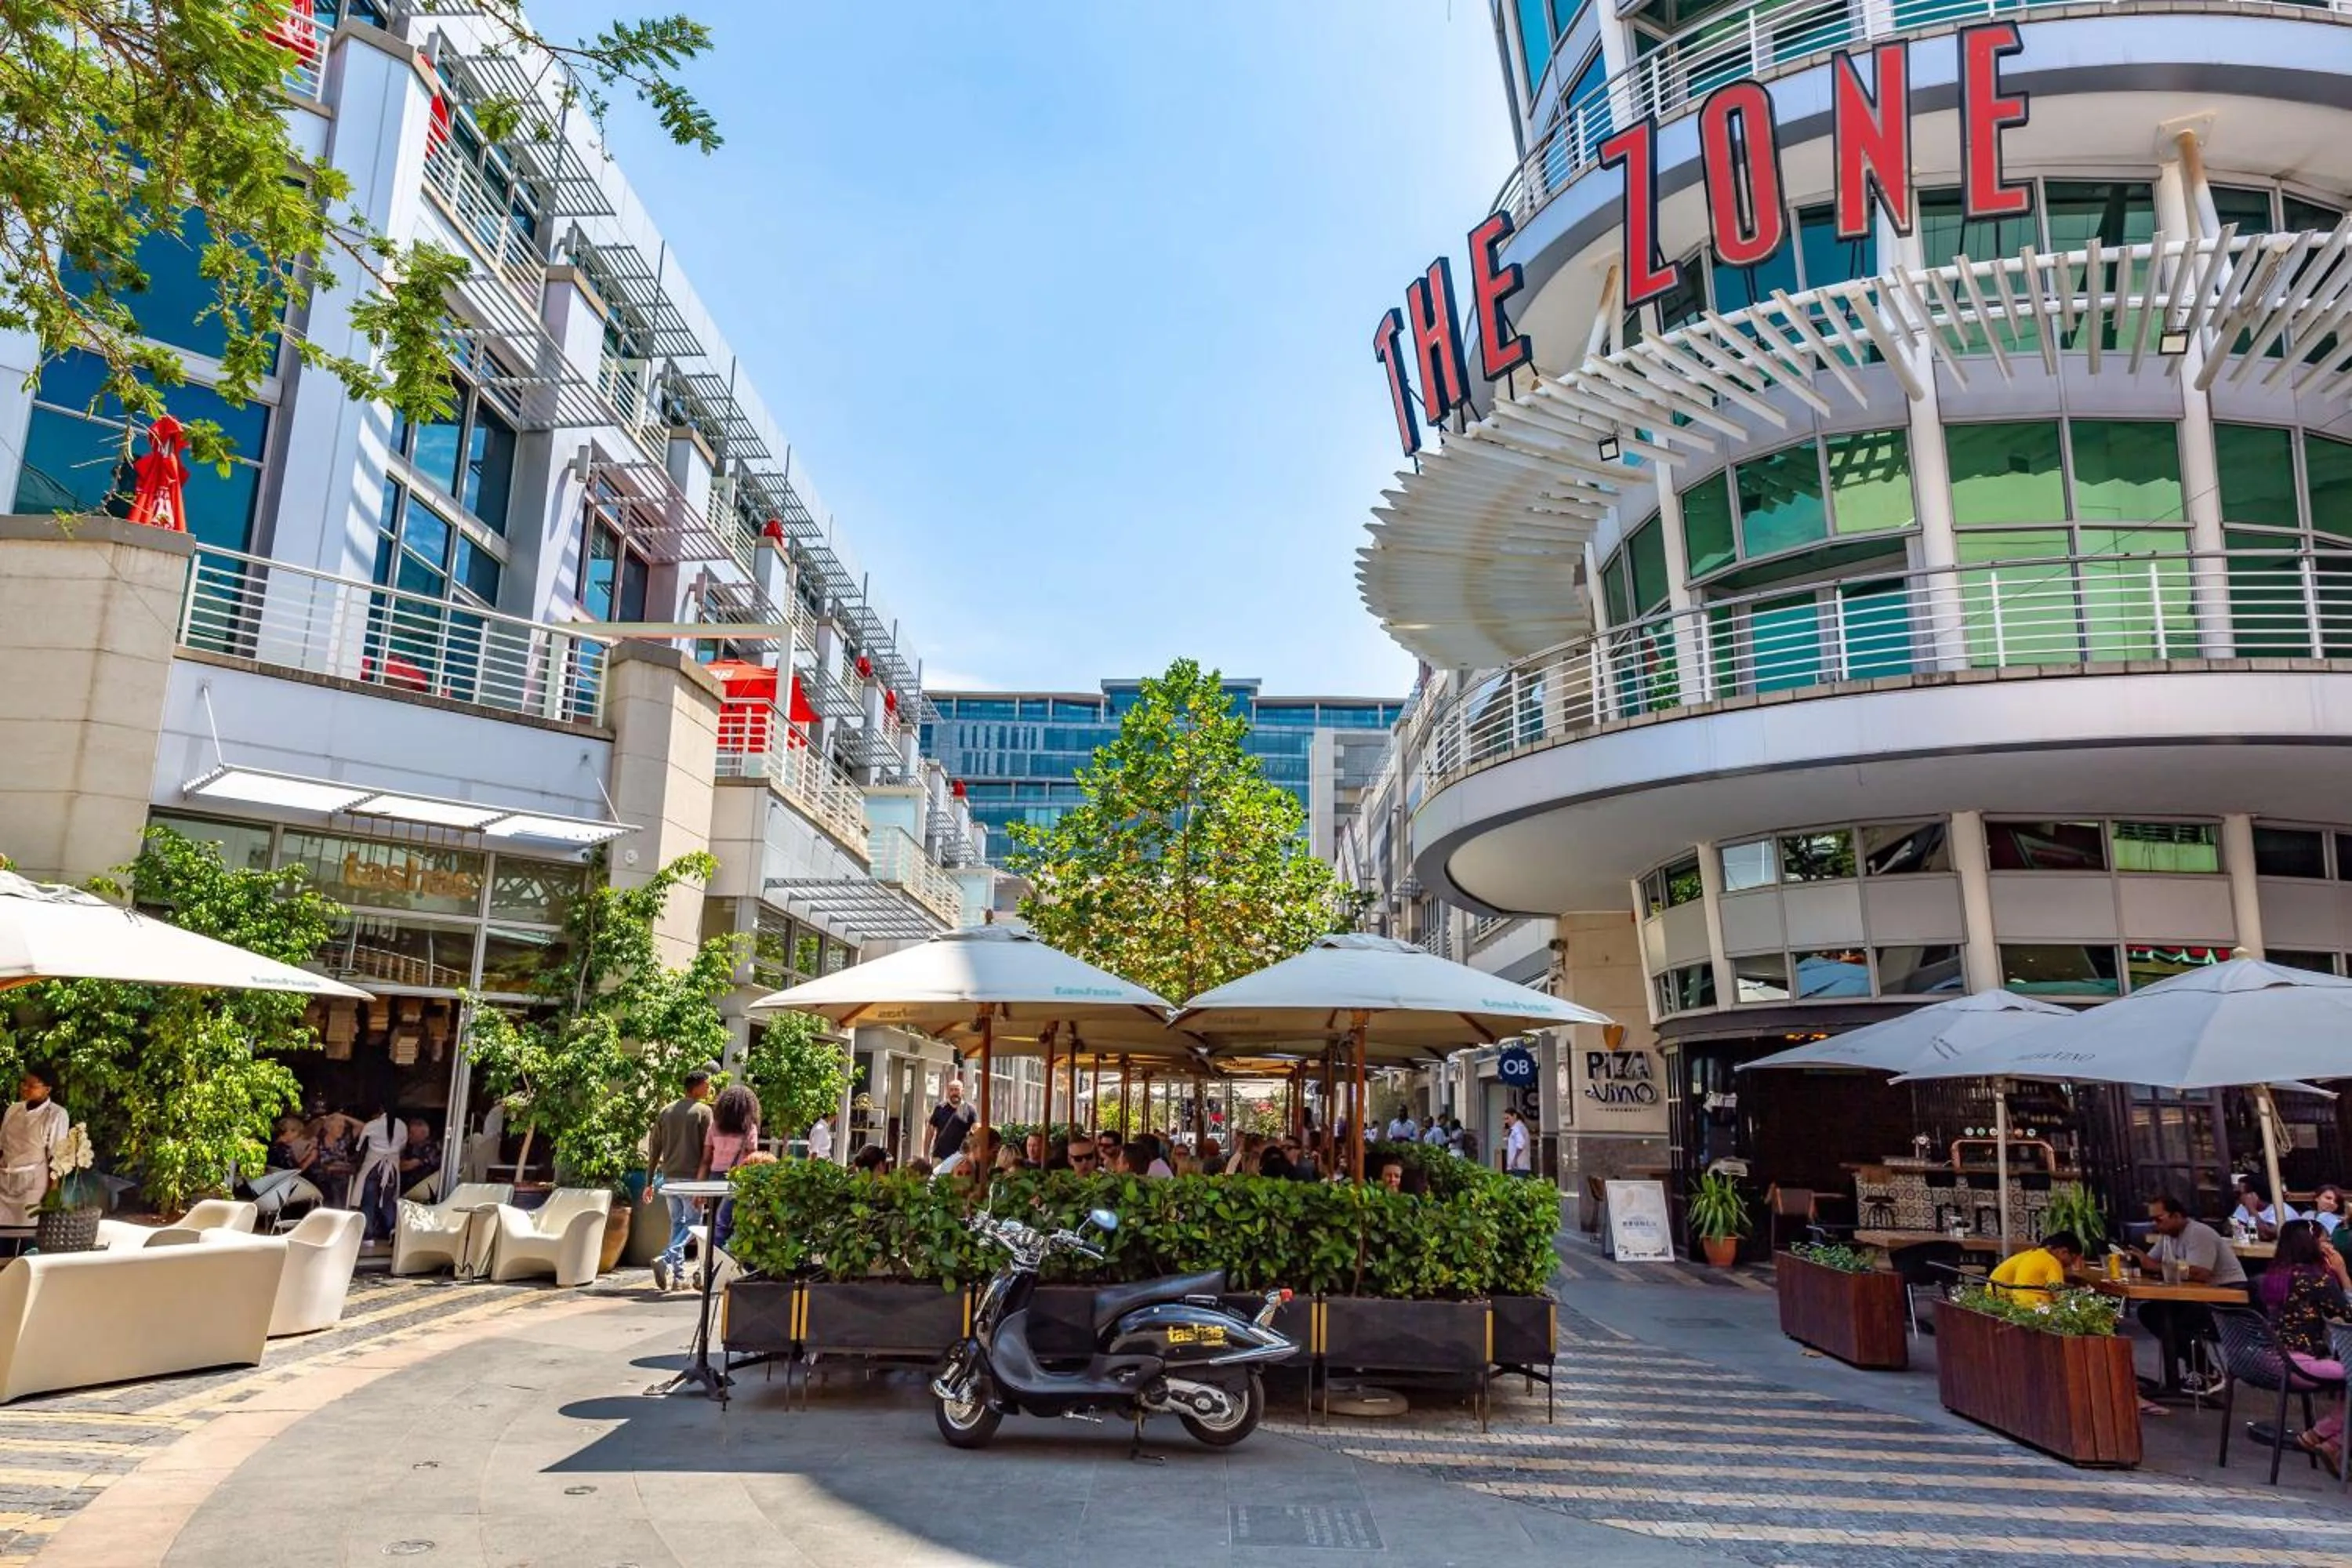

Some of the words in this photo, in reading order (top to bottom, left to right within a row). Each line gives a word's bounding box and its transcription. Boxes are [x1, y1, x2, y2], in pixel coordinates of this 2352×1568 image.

[1374, 209, 1533, 457] THE
[1597, 20, 2034, 309] ZONE
[343, 851, 480, 899] tashas
[1503, 1059, 1530, 1075] OB
[1167, 1323, 1225, 1343] tashas
